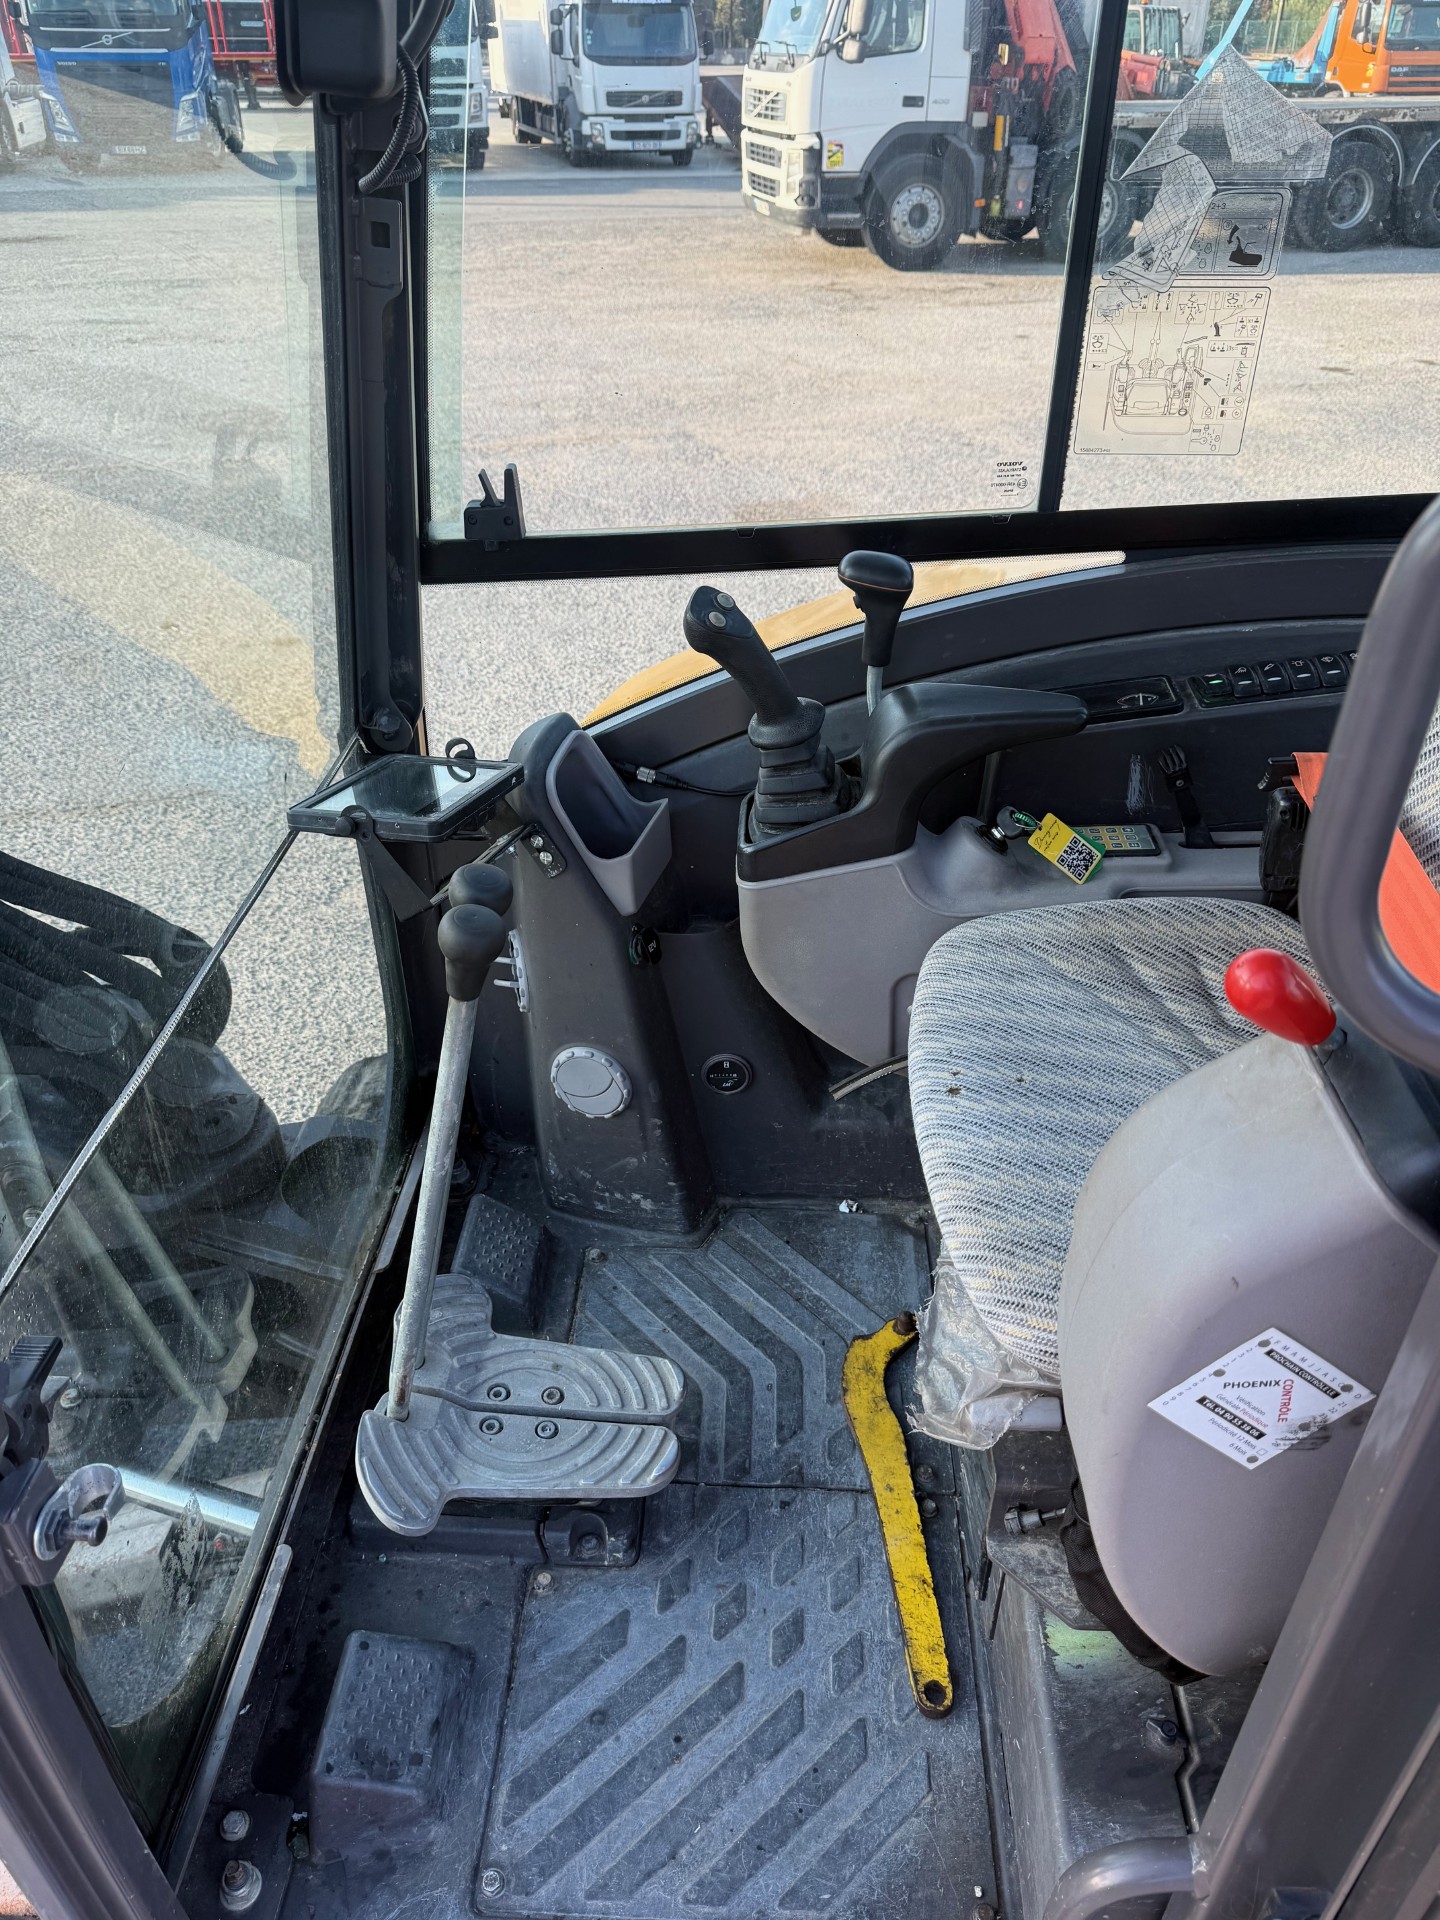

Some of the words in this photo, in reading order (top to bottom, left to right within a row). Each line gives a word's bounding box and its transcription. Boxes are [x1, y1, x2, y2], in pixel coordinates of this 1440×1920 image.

[1269, 1351, 1301, 1373] PROCHAIN
[1223, 1379, 1281, 1389] PHOENIX
[1216, 1393, 1241, 1411] Générale
[1239, 1407, 1269, 1428] Périodique
[1236, 1395, 1266, 1417] Vérification
[1277, 1378, 1295, 1423] CONTRÔLE
[1202, 1399, 1214, 1410] Tél.
[1214, 1407, 1226, 1416] 04
[1232, 1417, 1243, 1426] 55
[1249, 1428, 1260, 1437] 06
[1208, 1417, 1237, 1438] Périodicité
[1236, 1435, 1245, 1443] 12
[1243, 1439, 1257, 1450] Mois
[1233, 1445, 1248, 1456] Mois
